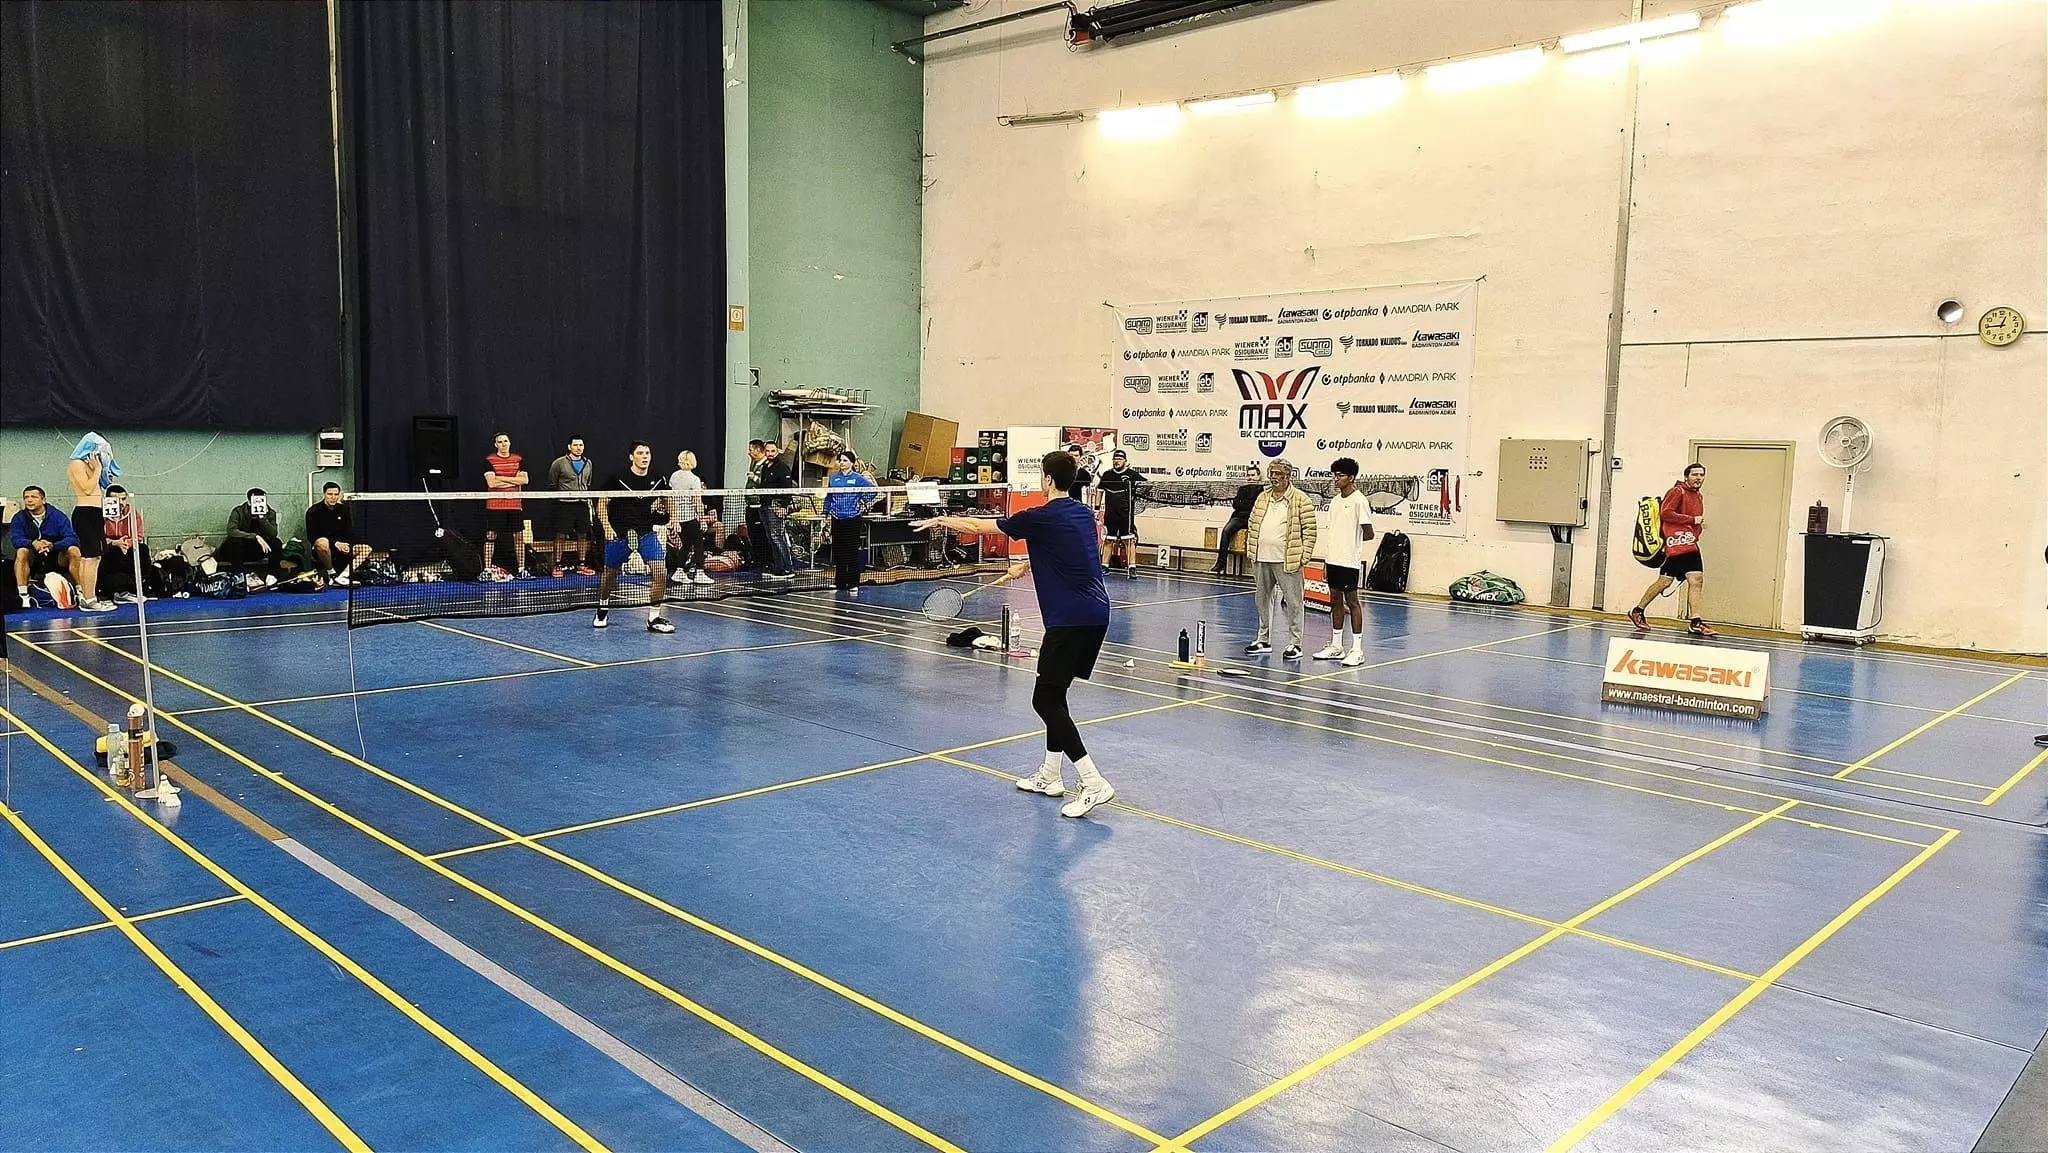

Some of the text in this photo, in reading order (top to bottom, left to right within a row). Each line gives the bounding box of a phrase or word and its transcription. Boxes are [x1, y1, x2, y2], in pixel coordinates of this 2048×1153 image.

[1334, 306, 1379, 320] otpbanka
[1391, 302, 1460, 315] AMADRIA PARK
[1156, 314, 1179, 322] WIENER
[1155, 321, 1188, 329] OSIGURANJE
[1132, 349, 1168, 361] otpbanka
[1177, 348, 1231, 357] AMADRIA PARK
[1234, 348, 1269, 356] OSIGURANJE
[1333, 373, 1376, 386] otpbanka
[1387, 372, 1457, 382] AMADRIA PARK
[1157, 381, 1190, 389] OSIGURANJE
[1131, 407, 1166, 420] otpbanka
[1175, 409, 1228, 417] AMADRIA PARK
[1239, 404, 1308, 429] MAX
[1240, 430, 1305, 438] BK CONCORDIA
[1328, 438, 1373, 451] otpbanka
[1385, 441, 1453, 450] AMADRIA PARK
[1185, 467, 1223, 478] otpbanka
[104, 507, 119, 516] 13
[1409, 503, 1439, 511] WIENER
[1160, 548, 1168, 560] 2
[1612, 649, 1752, 688] kawasaki
[1608, 687, 1755, 715] www.maestral-badminton.com
